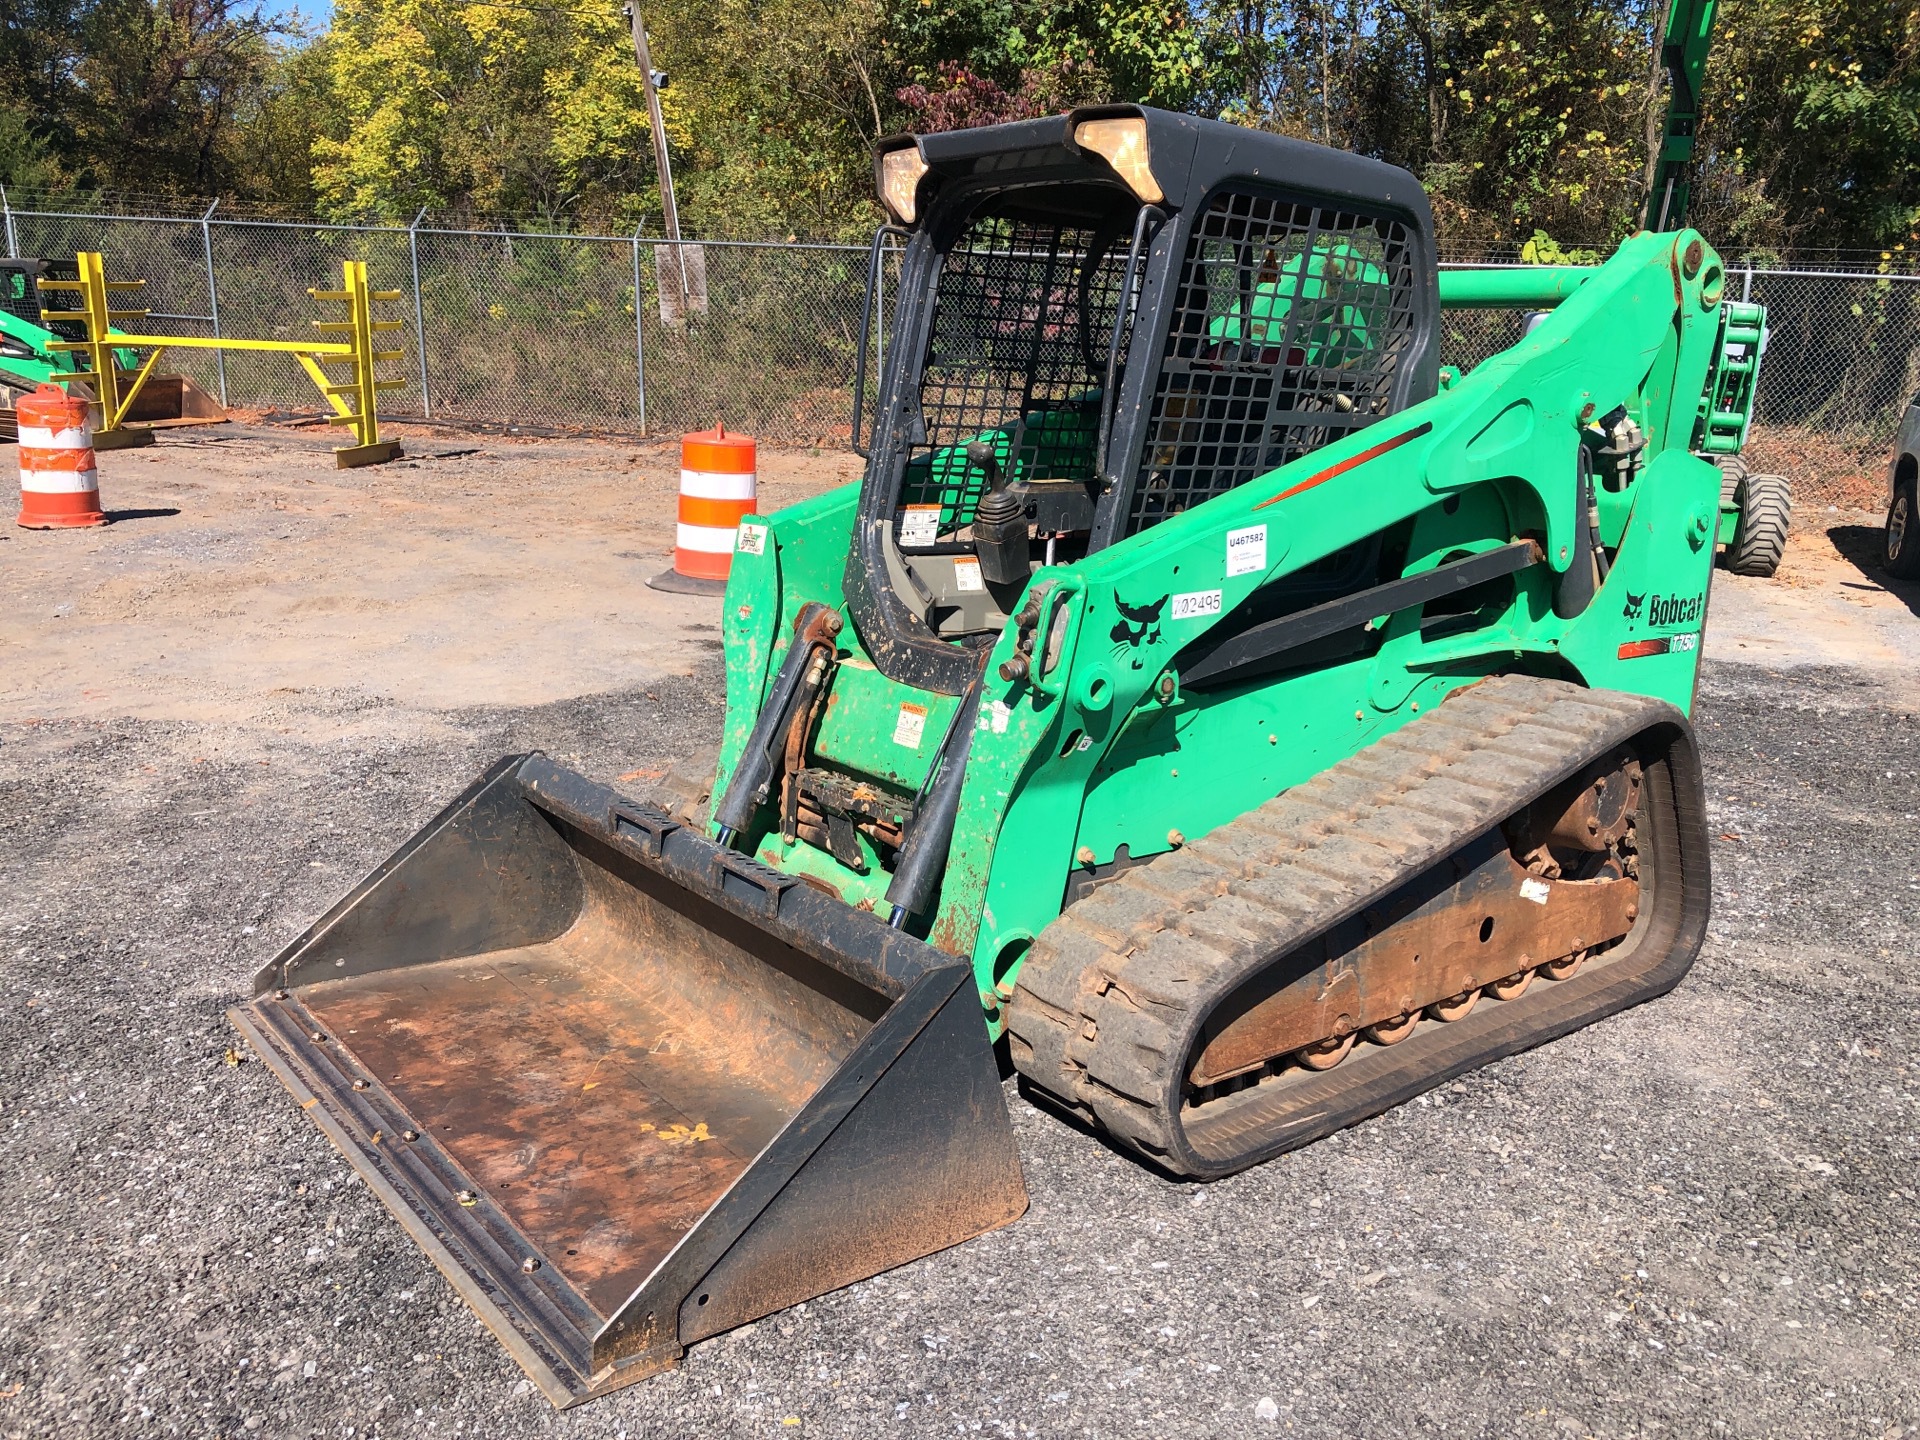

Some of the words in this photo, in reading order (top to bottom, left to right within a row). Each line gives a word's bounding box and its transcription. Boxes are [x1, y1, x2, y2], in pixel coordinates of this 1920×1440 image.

[1229, 532, 1264, 547] U467582
[1173, 594, 1220, 615] 702495
[1648, 592, 1703, 627] Bobcat
[1671, 634, 1697, 653] T750
